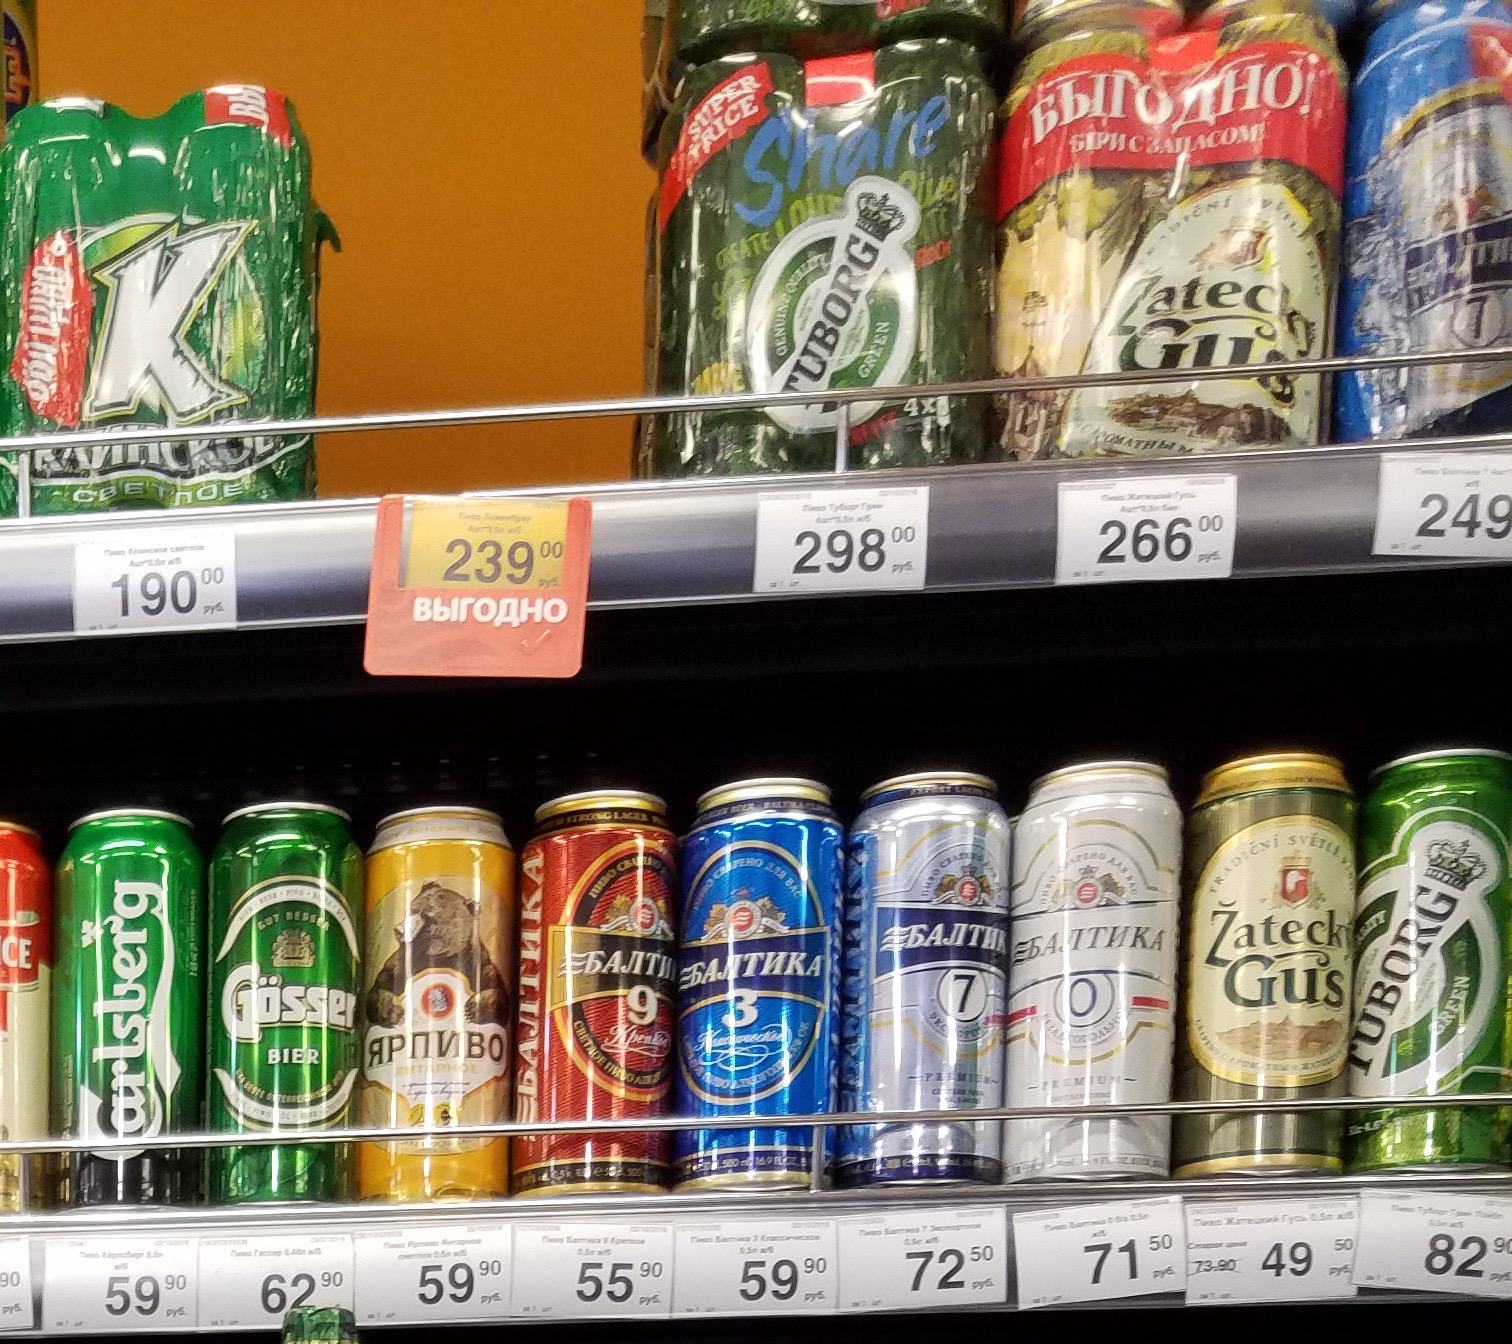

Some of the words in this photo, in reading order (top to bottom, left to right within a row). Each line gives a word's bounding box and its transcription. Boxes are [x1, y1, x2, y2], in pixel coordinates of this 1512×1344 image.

[1098, 519, 1192, 565] 266
[1198, 514, 1222, 532] 00
[444, 539, 537, 586] 239
[539, 542, 563, 559] 00
[112, 574, 197, 619] 190
[199, 568, 224, 586] 00
[413, 597, 568, 625] ВЫГОДНО
[1024, 924, 1163, 962] БАЛТИКА
[689, 953, 823, 984] БАЛТИКА
[1225, 955, 1344, 1010] Gus
[267, 1047, 319, 1064] BIER
[369, 1031, 504, 1067] ЯРПИВО
[577, 1262, 634, 1301] 55
[639, 1261, 663, 1279] 90
[740, 1259, 798, 1301] 59
[803, 1256, 827, 1275] 90
[906, 1250, 964, 1291] 72
[971, 1245, 993, 1262] 50
[106, 1278, 158, 1316] 59
[166, 1274, 187, 1291] 90
